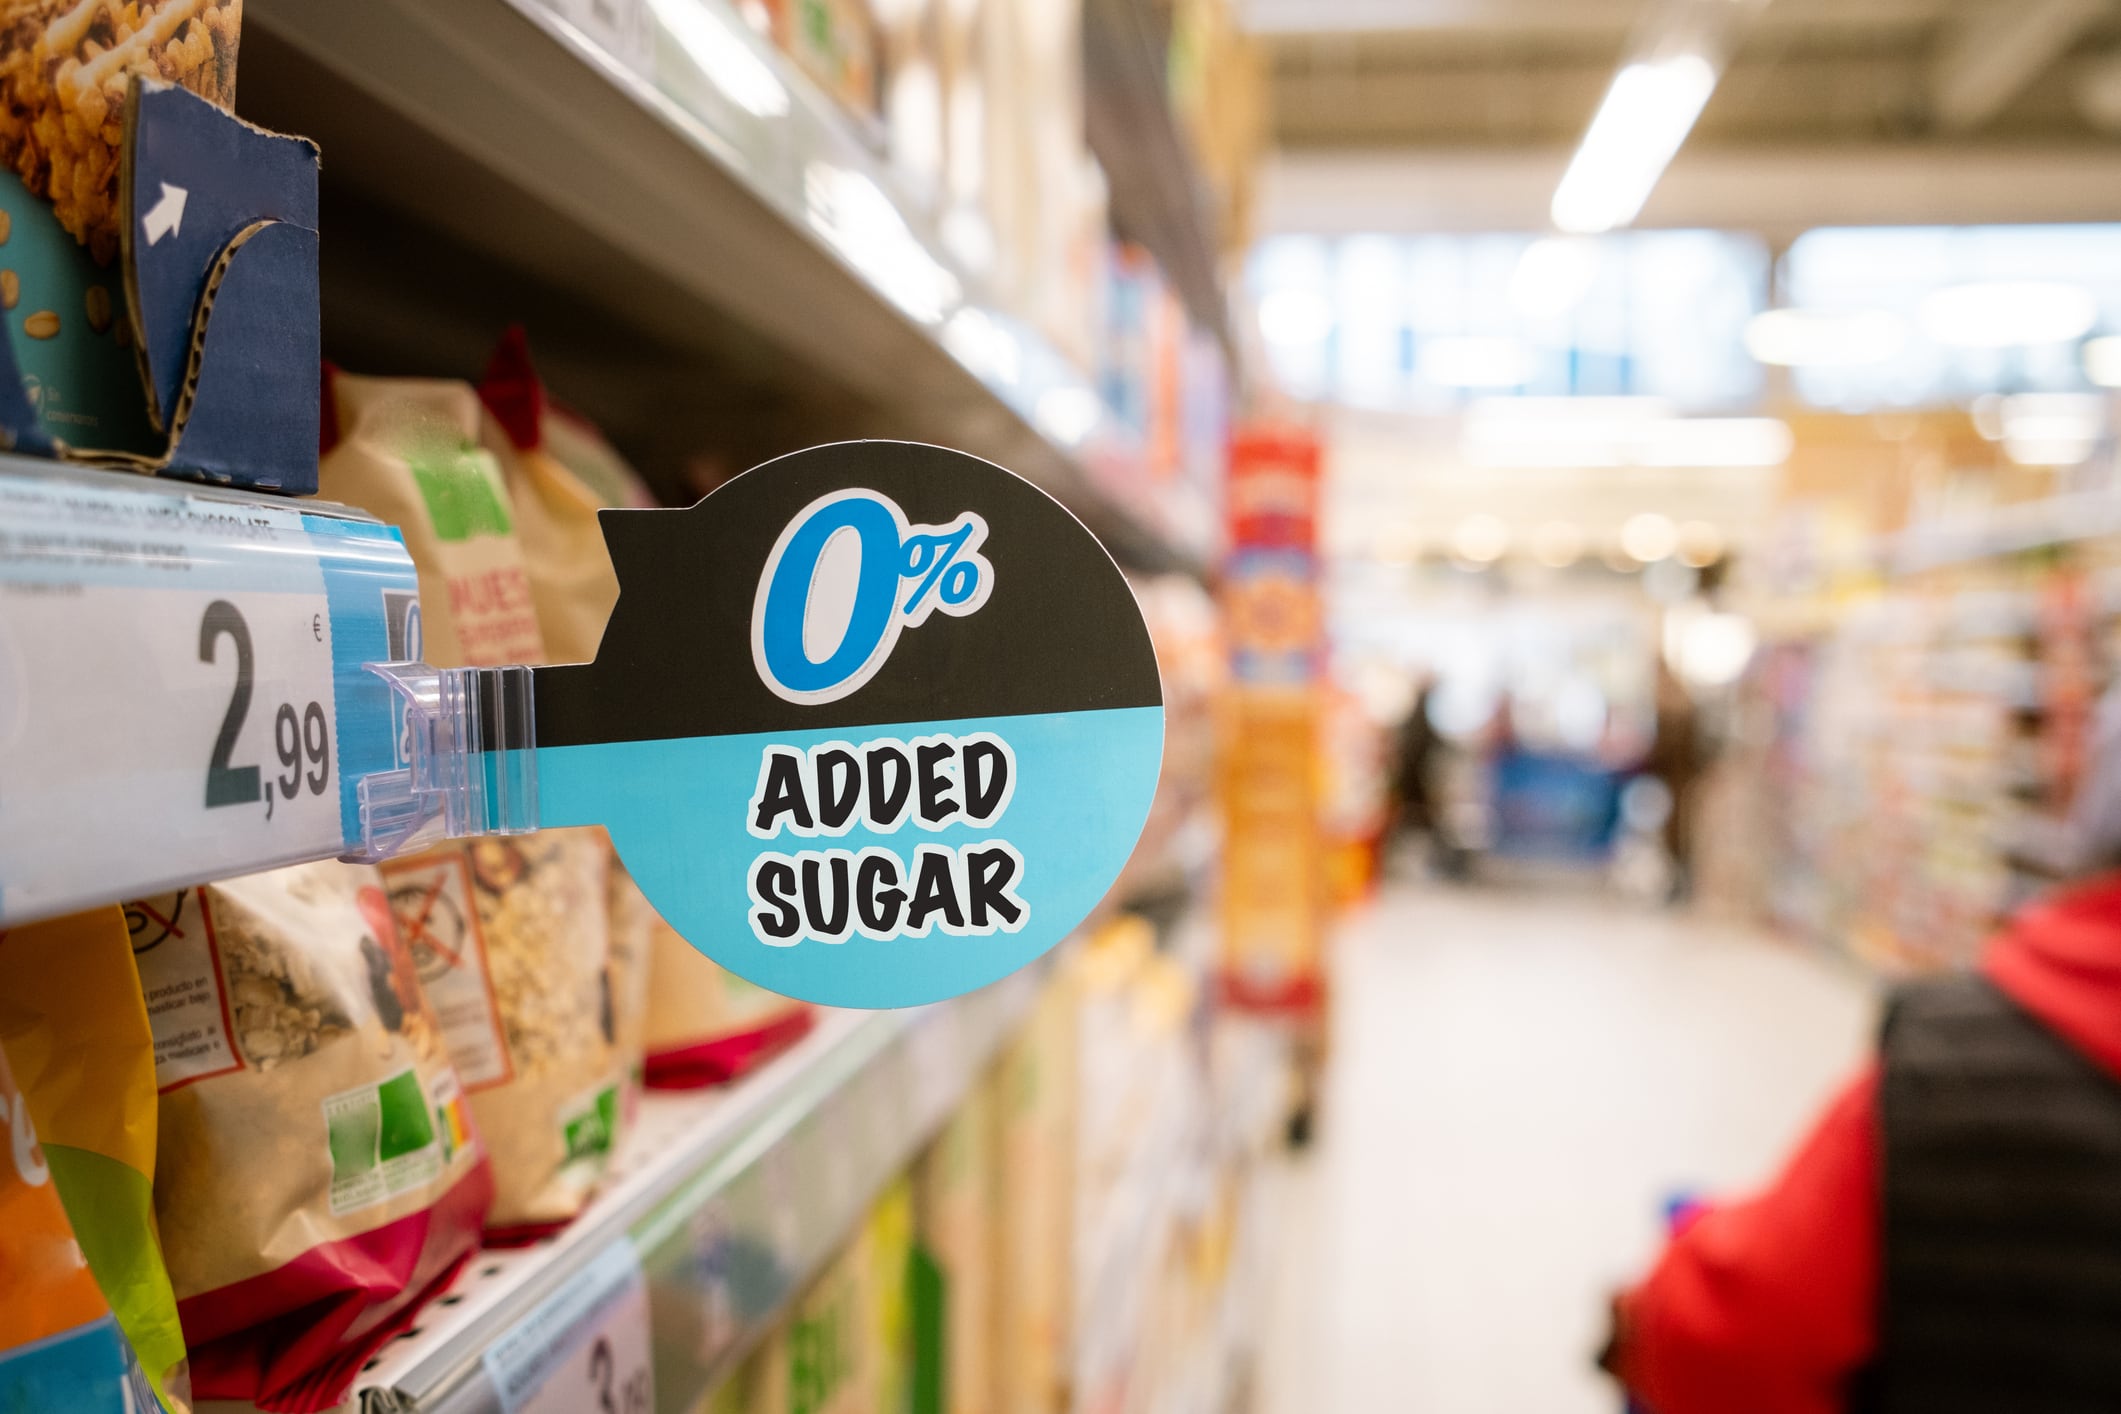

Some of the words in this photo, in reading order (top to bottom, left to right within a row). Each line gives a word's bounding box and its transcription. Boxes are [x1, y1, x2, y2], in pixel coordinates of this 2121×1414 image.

[312, 613, 323, 643] €
[757, 492, 986, 698] 0%
[198, 598, 330, 822] 2,99
[754, 740, 1009, 831] ADDED
[755, 847, 1022, 938] SUGAR
